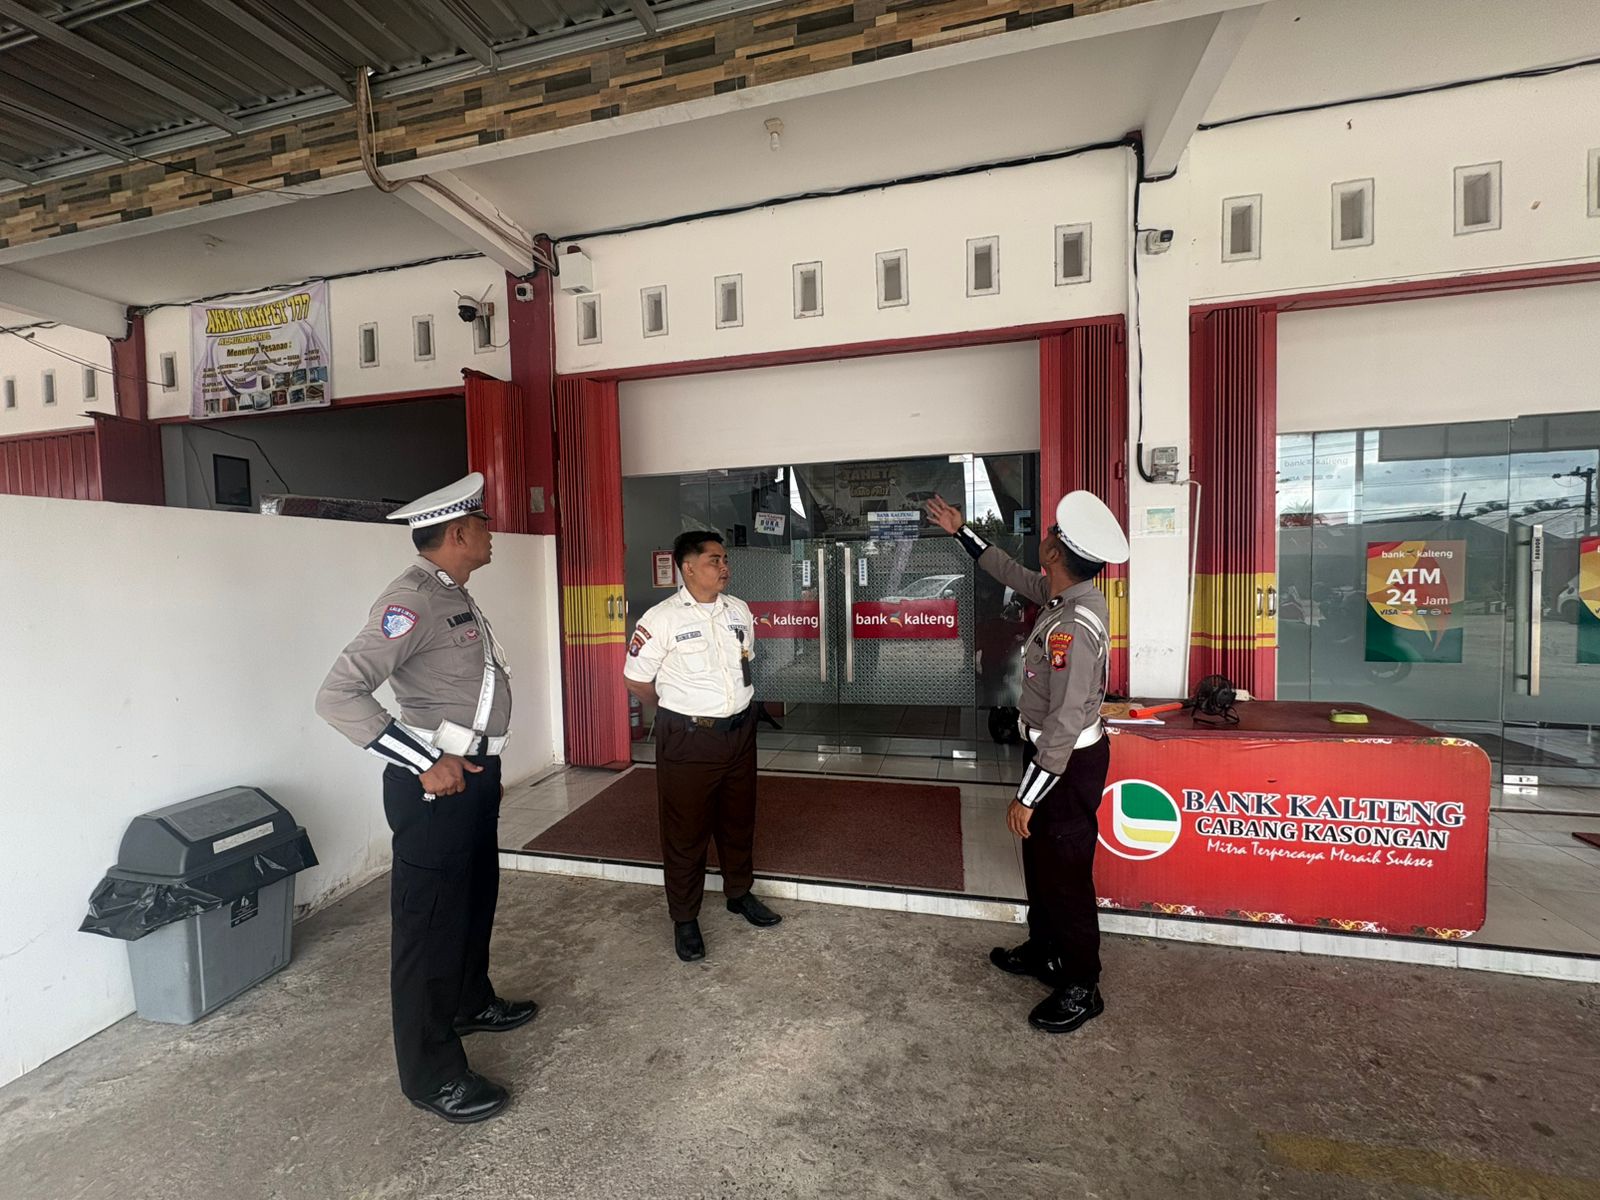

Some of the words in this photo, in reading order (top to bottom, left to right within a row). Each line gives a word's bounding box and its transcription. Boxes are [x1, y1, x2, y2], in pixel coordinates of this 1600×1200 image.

[286, 293, 311, 322] 777
[227, 346, 259, 357] Menerima
[261, 343, 287, 352] Pesanan
[760, 519, 779, 527] BUKA
[1382, 551, 1405, 559] bank
[1417, 550, 1453, 559] kalteng
[1386, 568, 1440, 585] ATM
[1386, 589, 1417, 605] 24
[1422, 596, 1448, 605] Jam
[773, 613, 818, 628] kalteng
[855, 613, 888, 625] bank
[904, 613, 954, 628] kalteng
[1183, 789, 1280, 817] BANK
[1287, 795, 1465, 827] KALTENG
[1196, 817, 1297, 841] CABANG
[1302, 823, 1449, 851] KASONGAN
[1207, 838, 1247, 854] Mitra
[1251, 841, 1325, 865] Terpercaya
[1330, 847, 1381, 864] Meraih
[1386, 850, 1434, 868] Sukses
